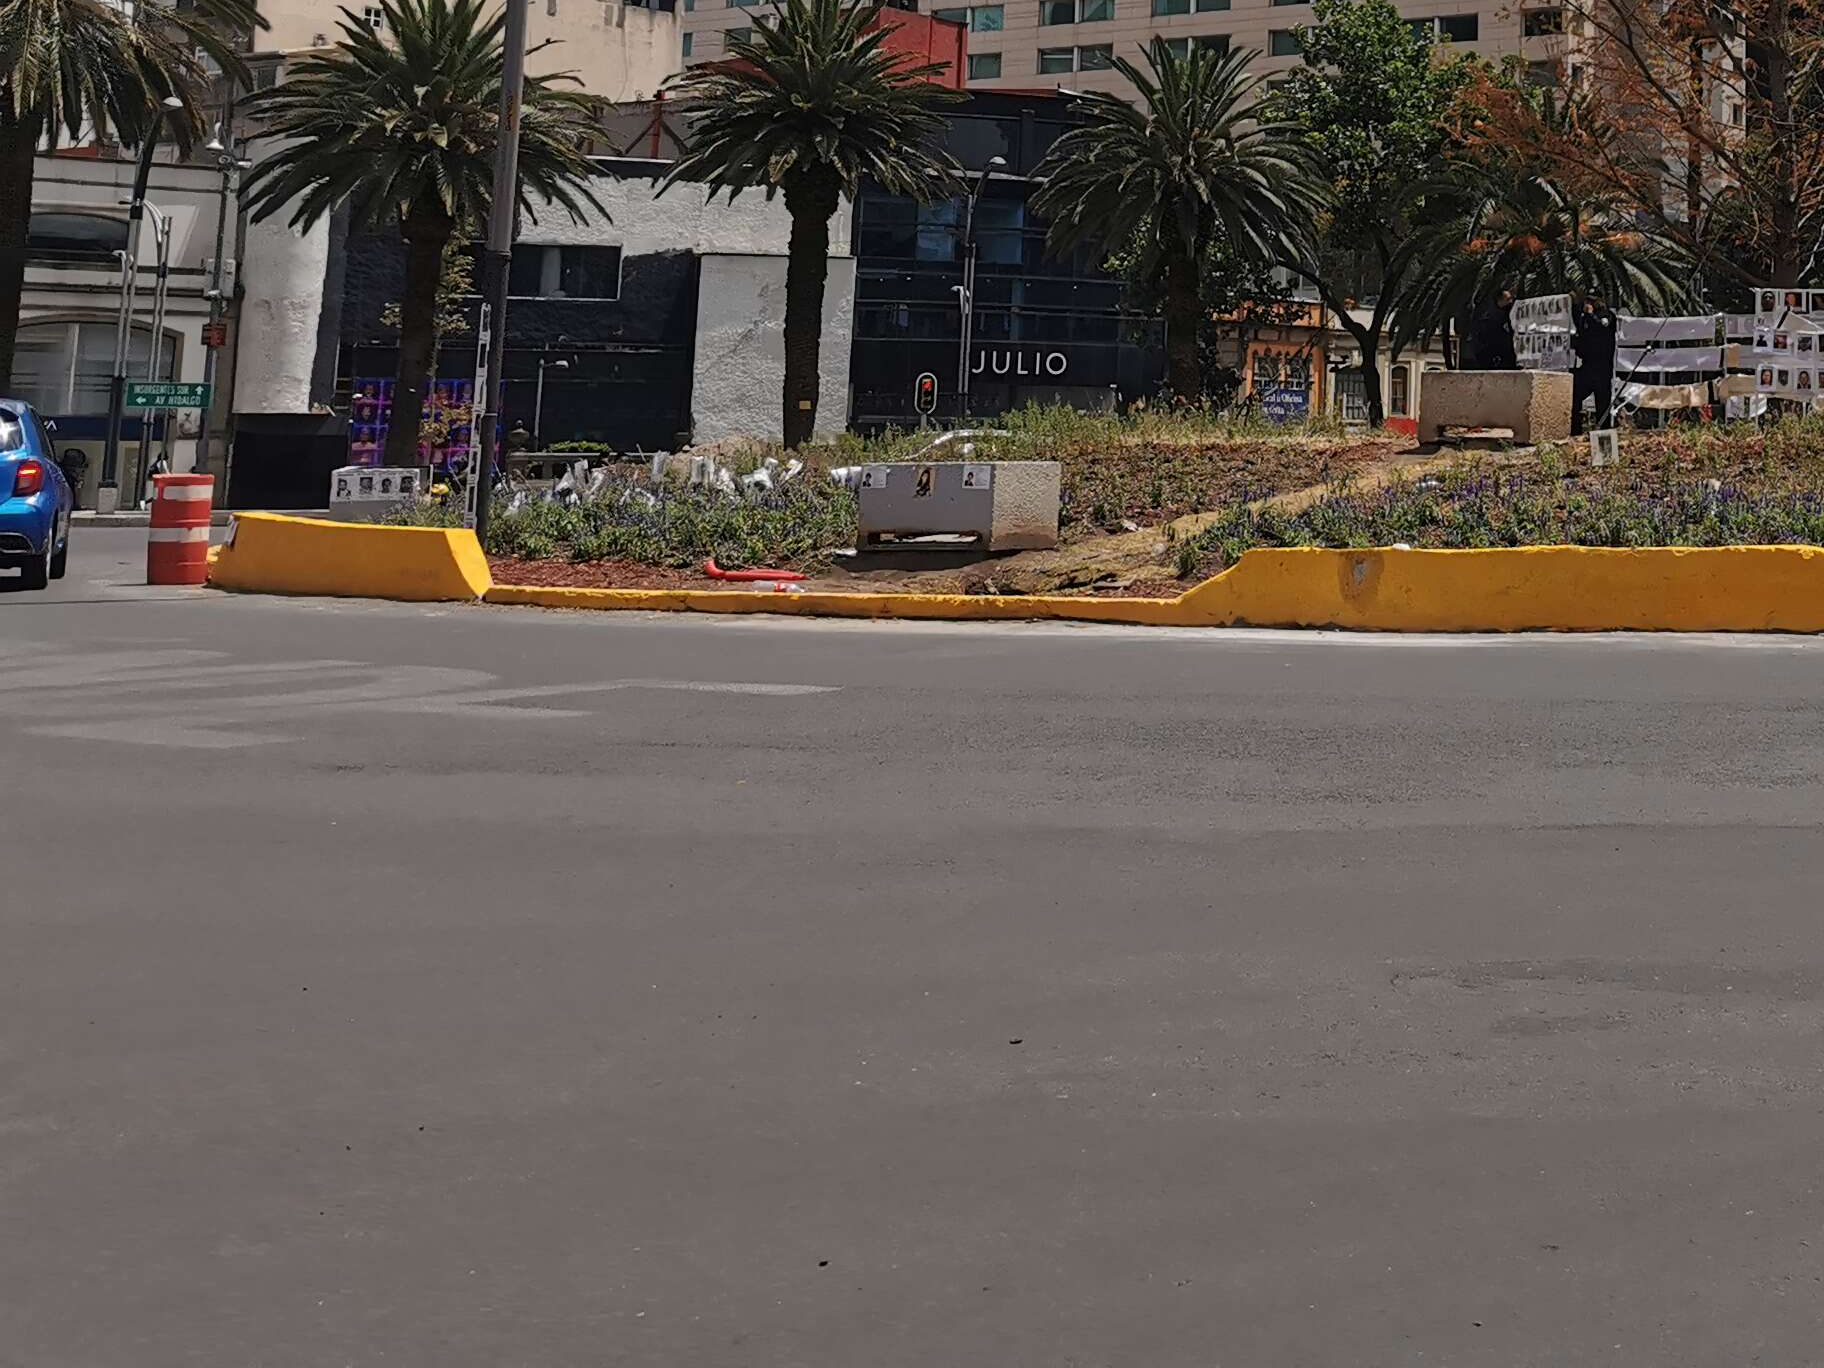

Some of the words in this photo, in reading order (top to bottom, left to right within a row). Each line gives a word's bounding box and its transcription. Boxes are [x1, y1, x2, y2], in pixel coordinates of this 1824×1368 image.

[971, 350, 1067, 375] JULIO
[154, 395, 166, 405] AV
[167, 395, 202, 406] HIDALGO
